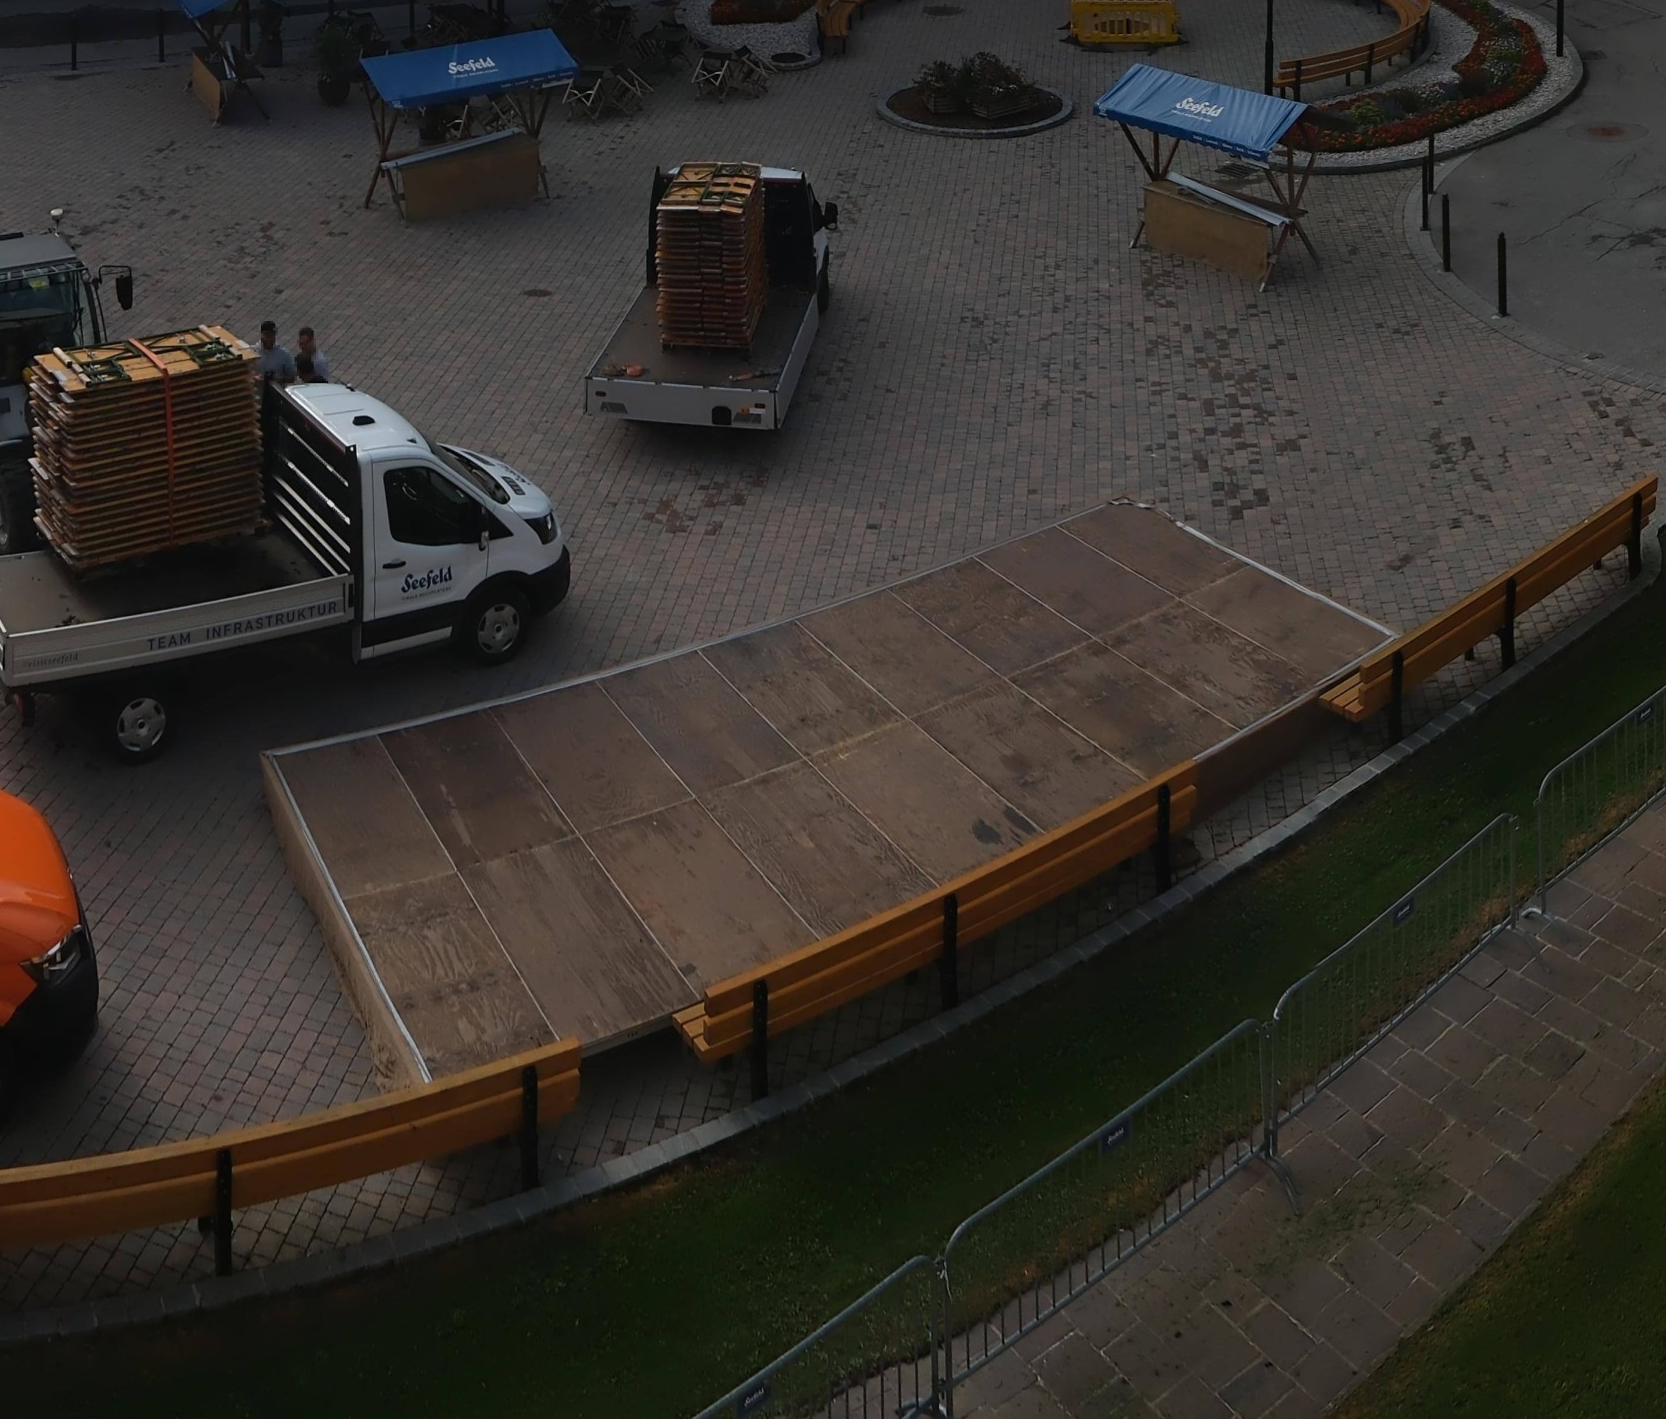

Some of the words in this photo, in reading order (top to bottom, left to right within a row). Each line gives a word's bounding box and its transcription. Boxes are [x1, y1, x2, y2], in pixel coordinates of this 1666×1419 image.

[448, 56, 496, 75] Seefeld
[1175, 96, 1225, 118] Seefeld
[401, 566, 453, 593] Seefeld
[147, 632, 191, 651] TEAM
[206, 601, 338, 640] INFRASTRUKTUR
